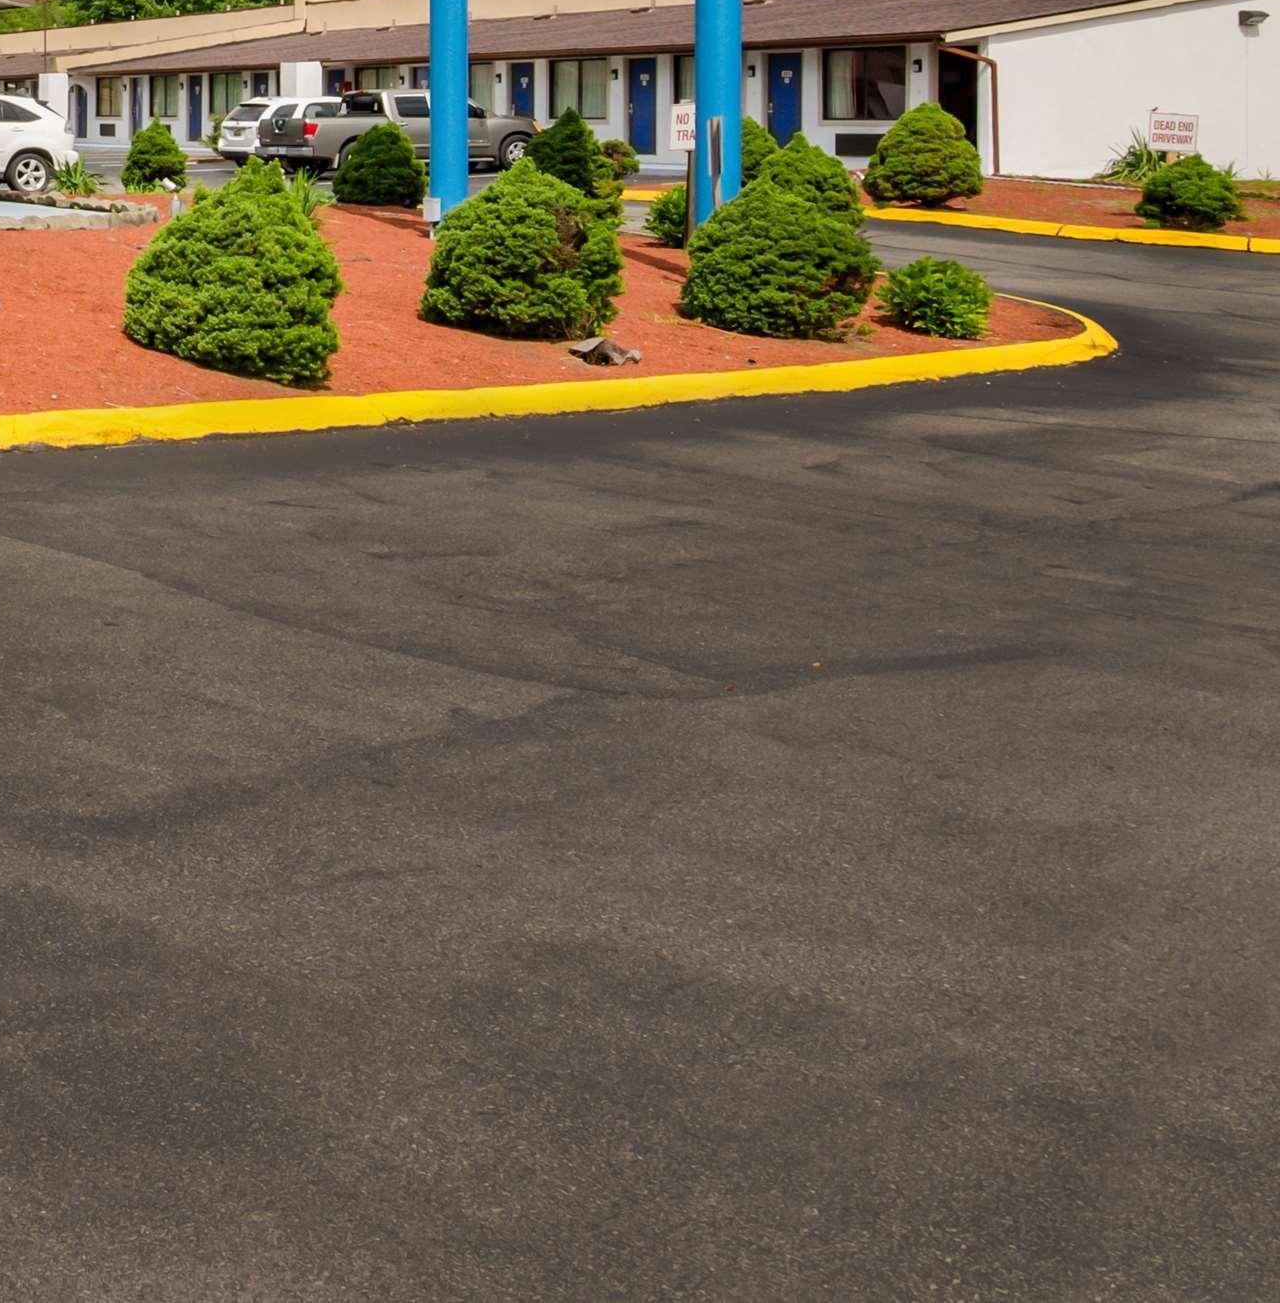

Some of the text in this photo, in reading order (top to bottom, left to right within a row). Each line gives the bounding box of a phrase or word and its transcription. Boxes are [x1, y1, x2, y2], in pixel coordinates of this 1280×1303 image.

[676, 113, 690, 126] NO
[1153, 119, 1194, 133] DEAD END
[676, 129, 696, 142] TRA
[1151, 133, 1194, 144] DRIVEWAY
